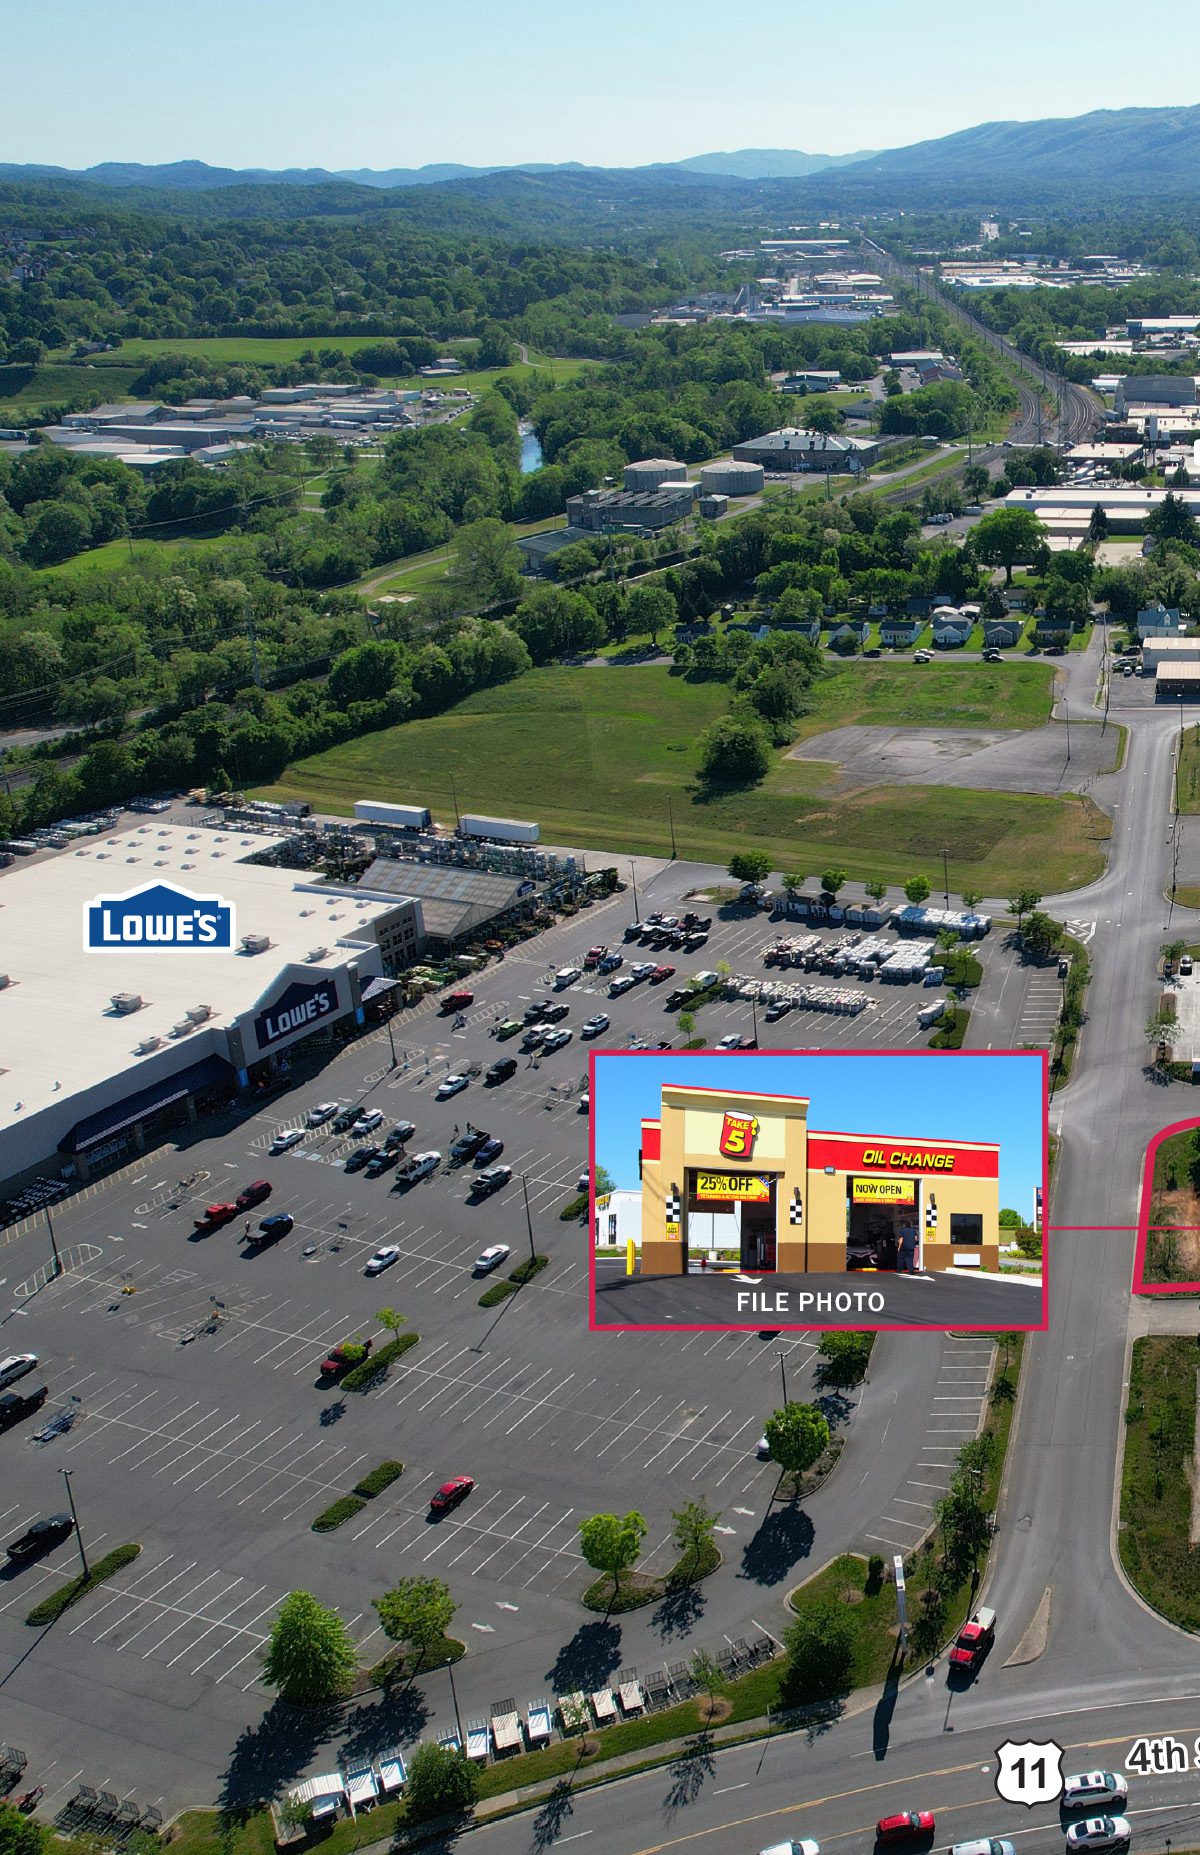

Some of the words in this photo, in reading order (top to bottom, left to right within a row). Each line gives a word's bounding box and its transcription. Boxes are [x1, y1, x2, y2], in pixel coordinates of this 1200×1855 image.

[265, 991, 330, 1040] LOWE'S
[726, 1117, 750, 1130] TAKE
[724, 1129, 745, 1153] 5
[862, 1149, 887, 1164] OIL
[889, 1151, 955, 1168] CHANGE
[700, 1176, 727, 1191] 25%
[728, 1177, 753, 1191] OFF
[855, 1184, 878, 1194] NOW
[879, 1185, 902, 1194] OPEN
